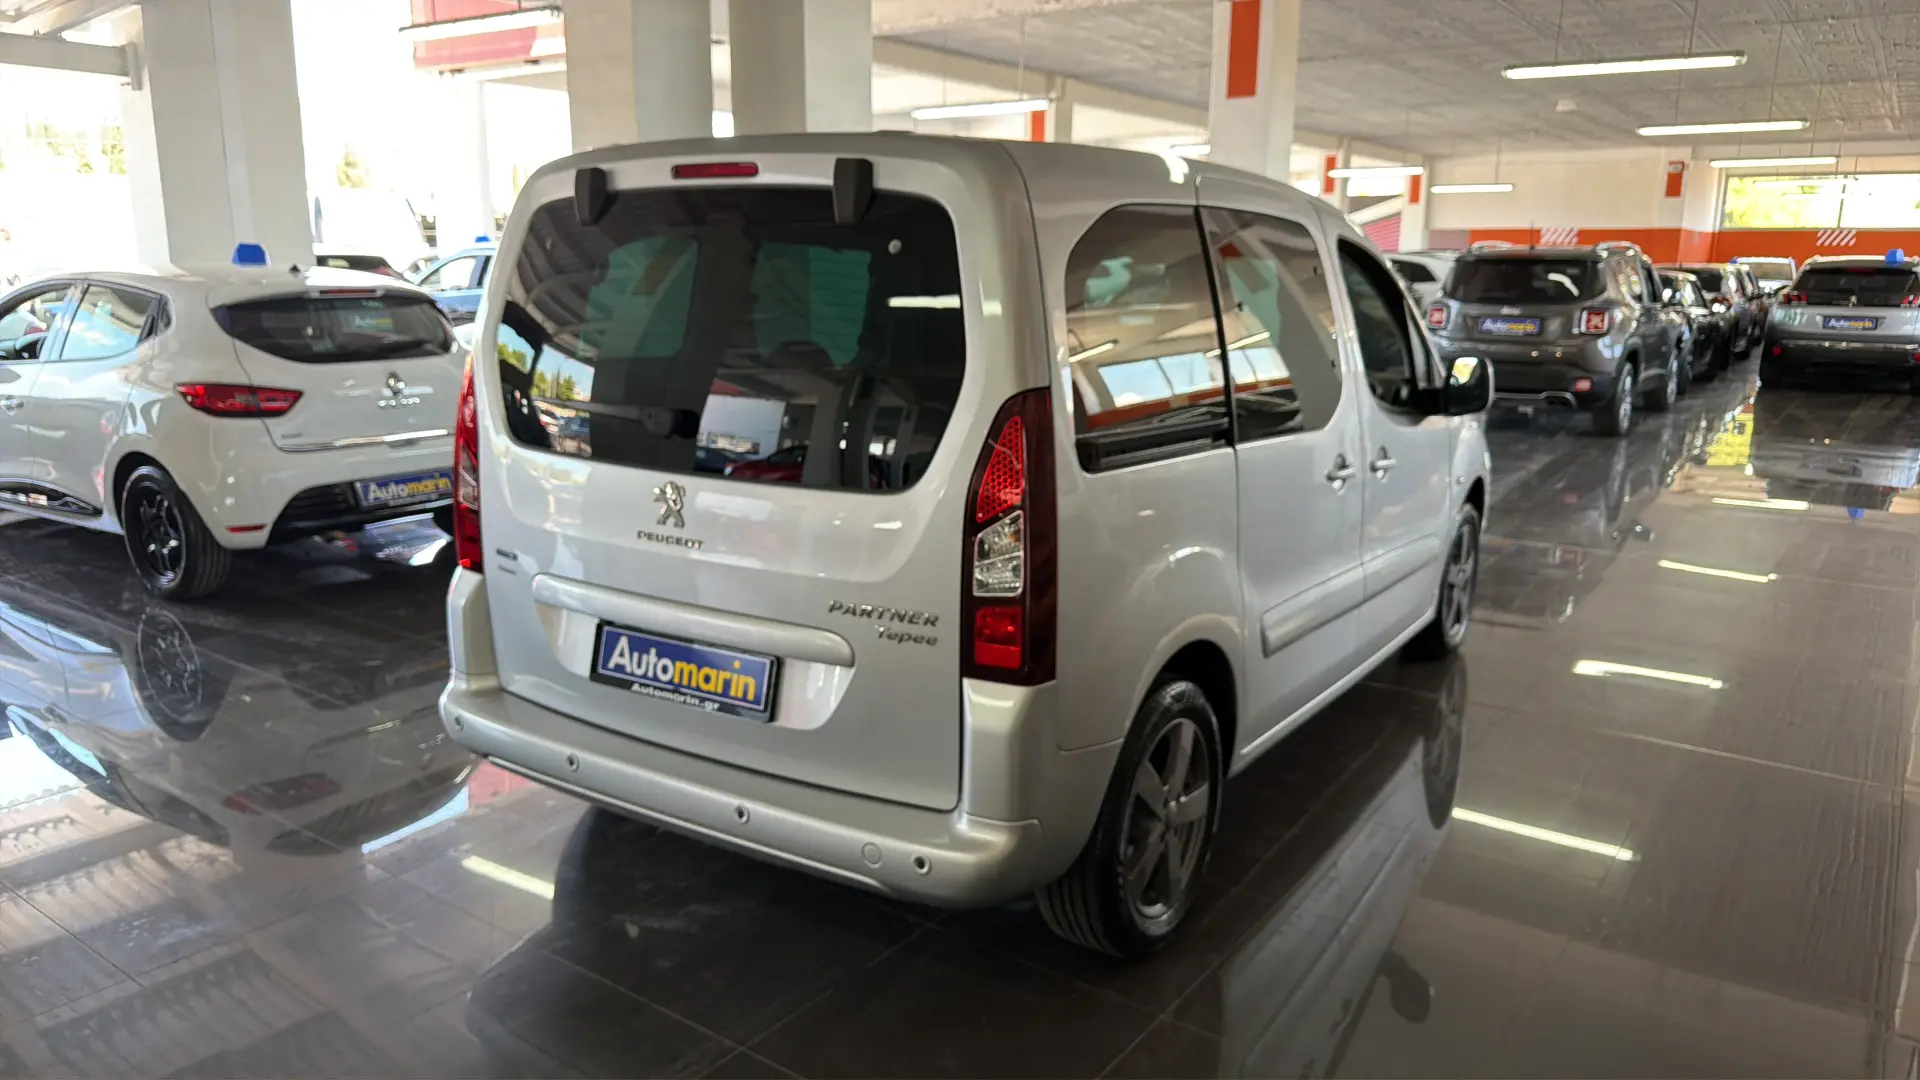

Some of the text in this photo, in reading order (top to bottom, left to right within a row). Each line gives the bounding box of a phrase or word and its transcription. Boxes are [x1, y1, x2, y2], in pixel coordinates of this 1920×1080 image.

[368, 472, 450, 503] Automarin
[637, 530, 704, 550] PEUGEOT
[828, 600, 939, 627] PARTNER
[874, 624, 938, 645] Tepee
[608, 635, 756, 701] Automarin
[631, 683, 720, 712] Automarin.gr
